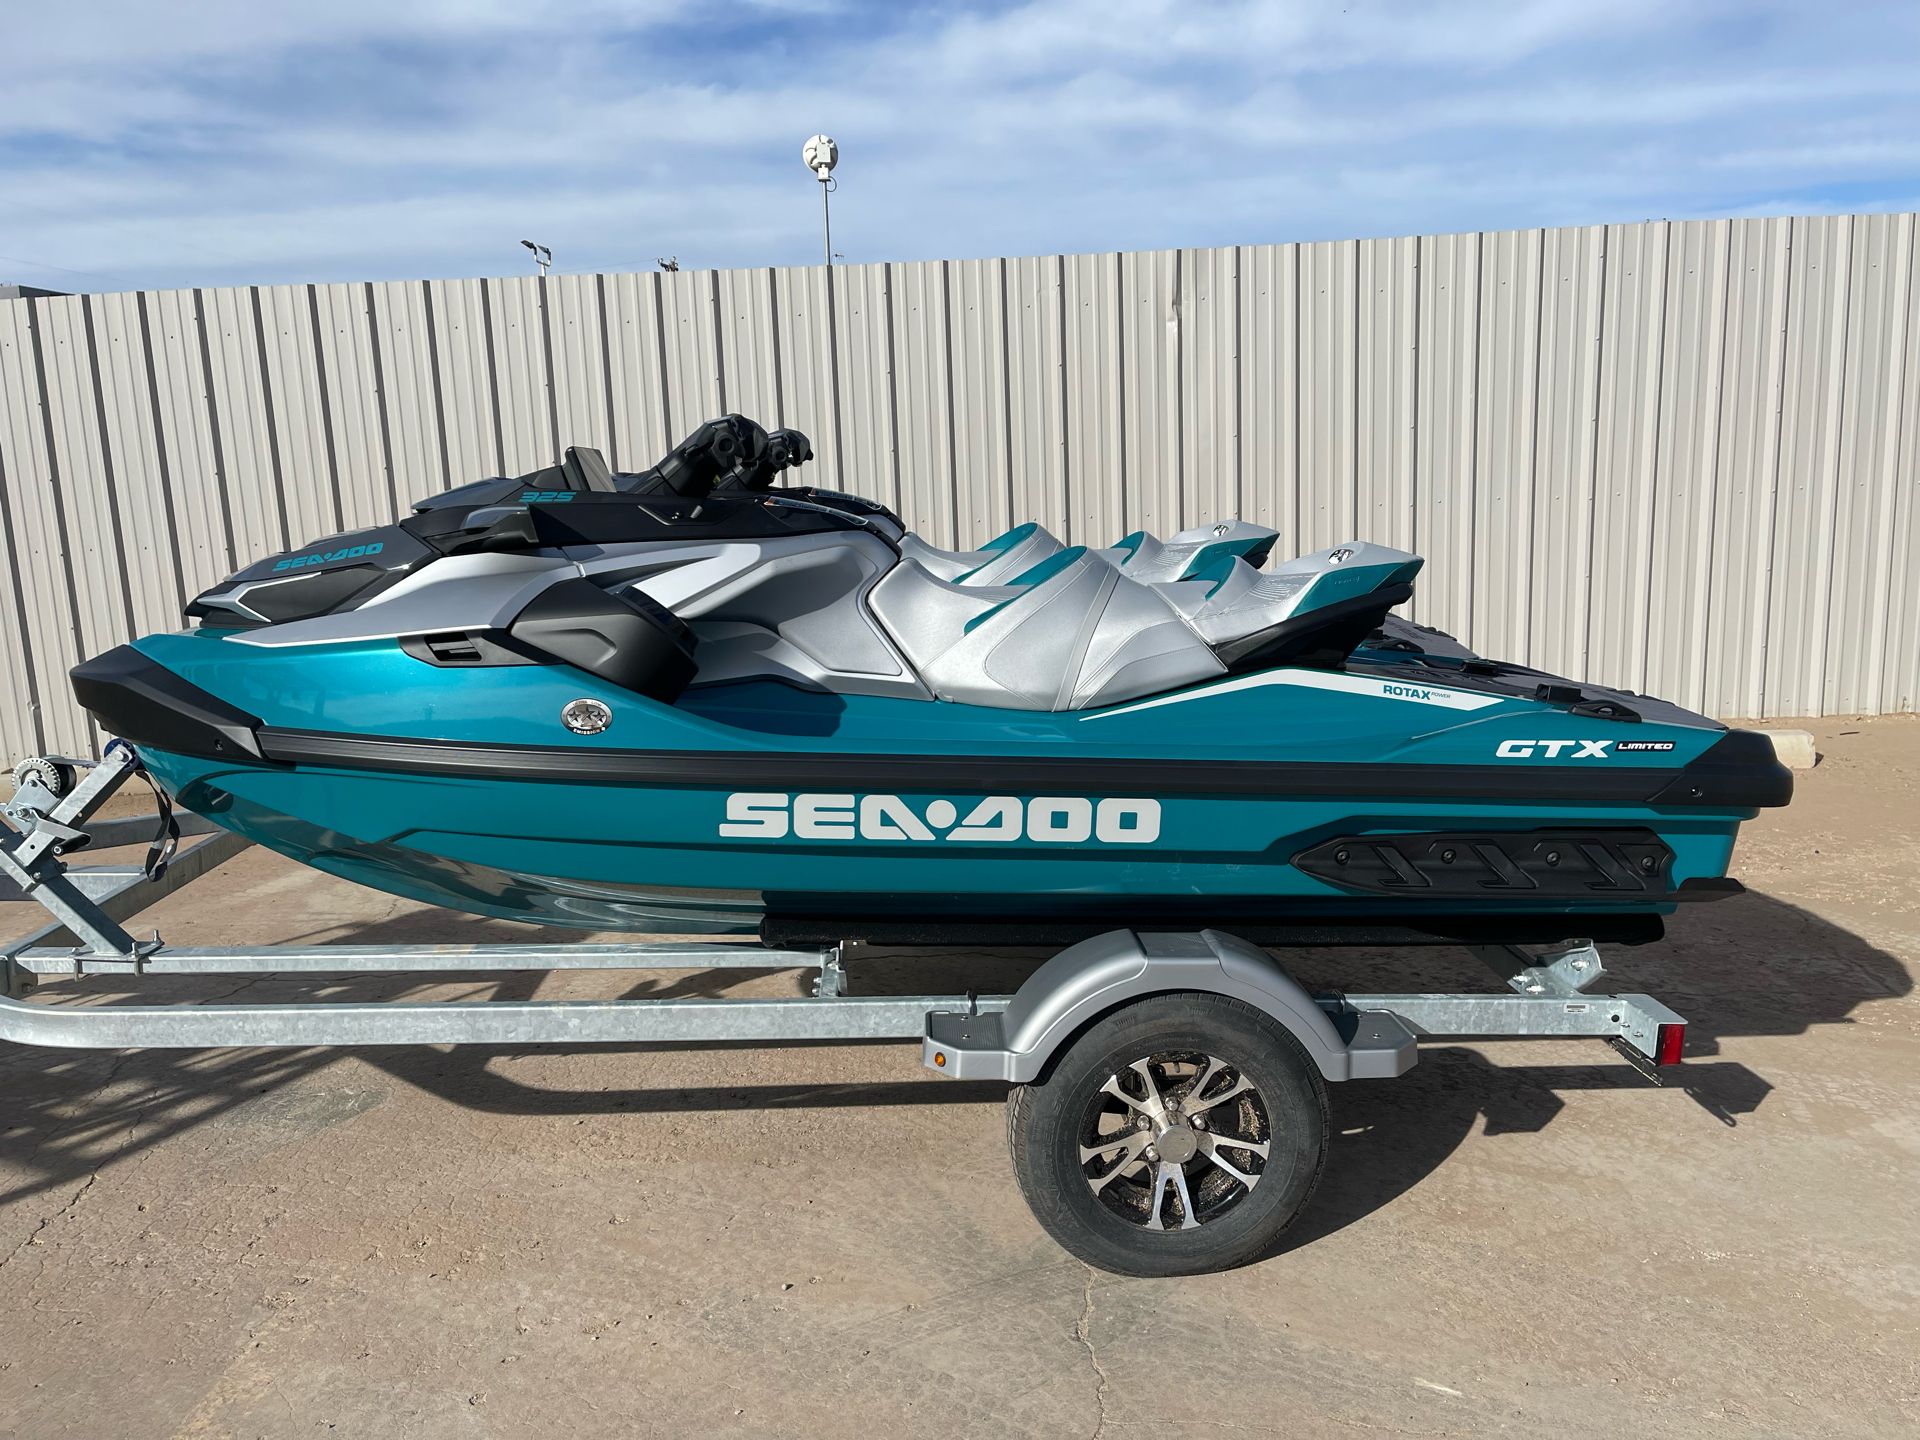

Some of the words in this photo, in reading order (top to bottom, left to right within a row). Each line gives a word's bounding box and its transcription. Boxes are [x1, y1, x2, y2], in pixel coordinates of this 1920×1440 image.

[518, 491, 577, 504] 325
[1383, 684, 1431, 700] ROTAX
[1495, 739, 1614, 758] GTX
[1617, 742, 1674, 750] LIMITED
